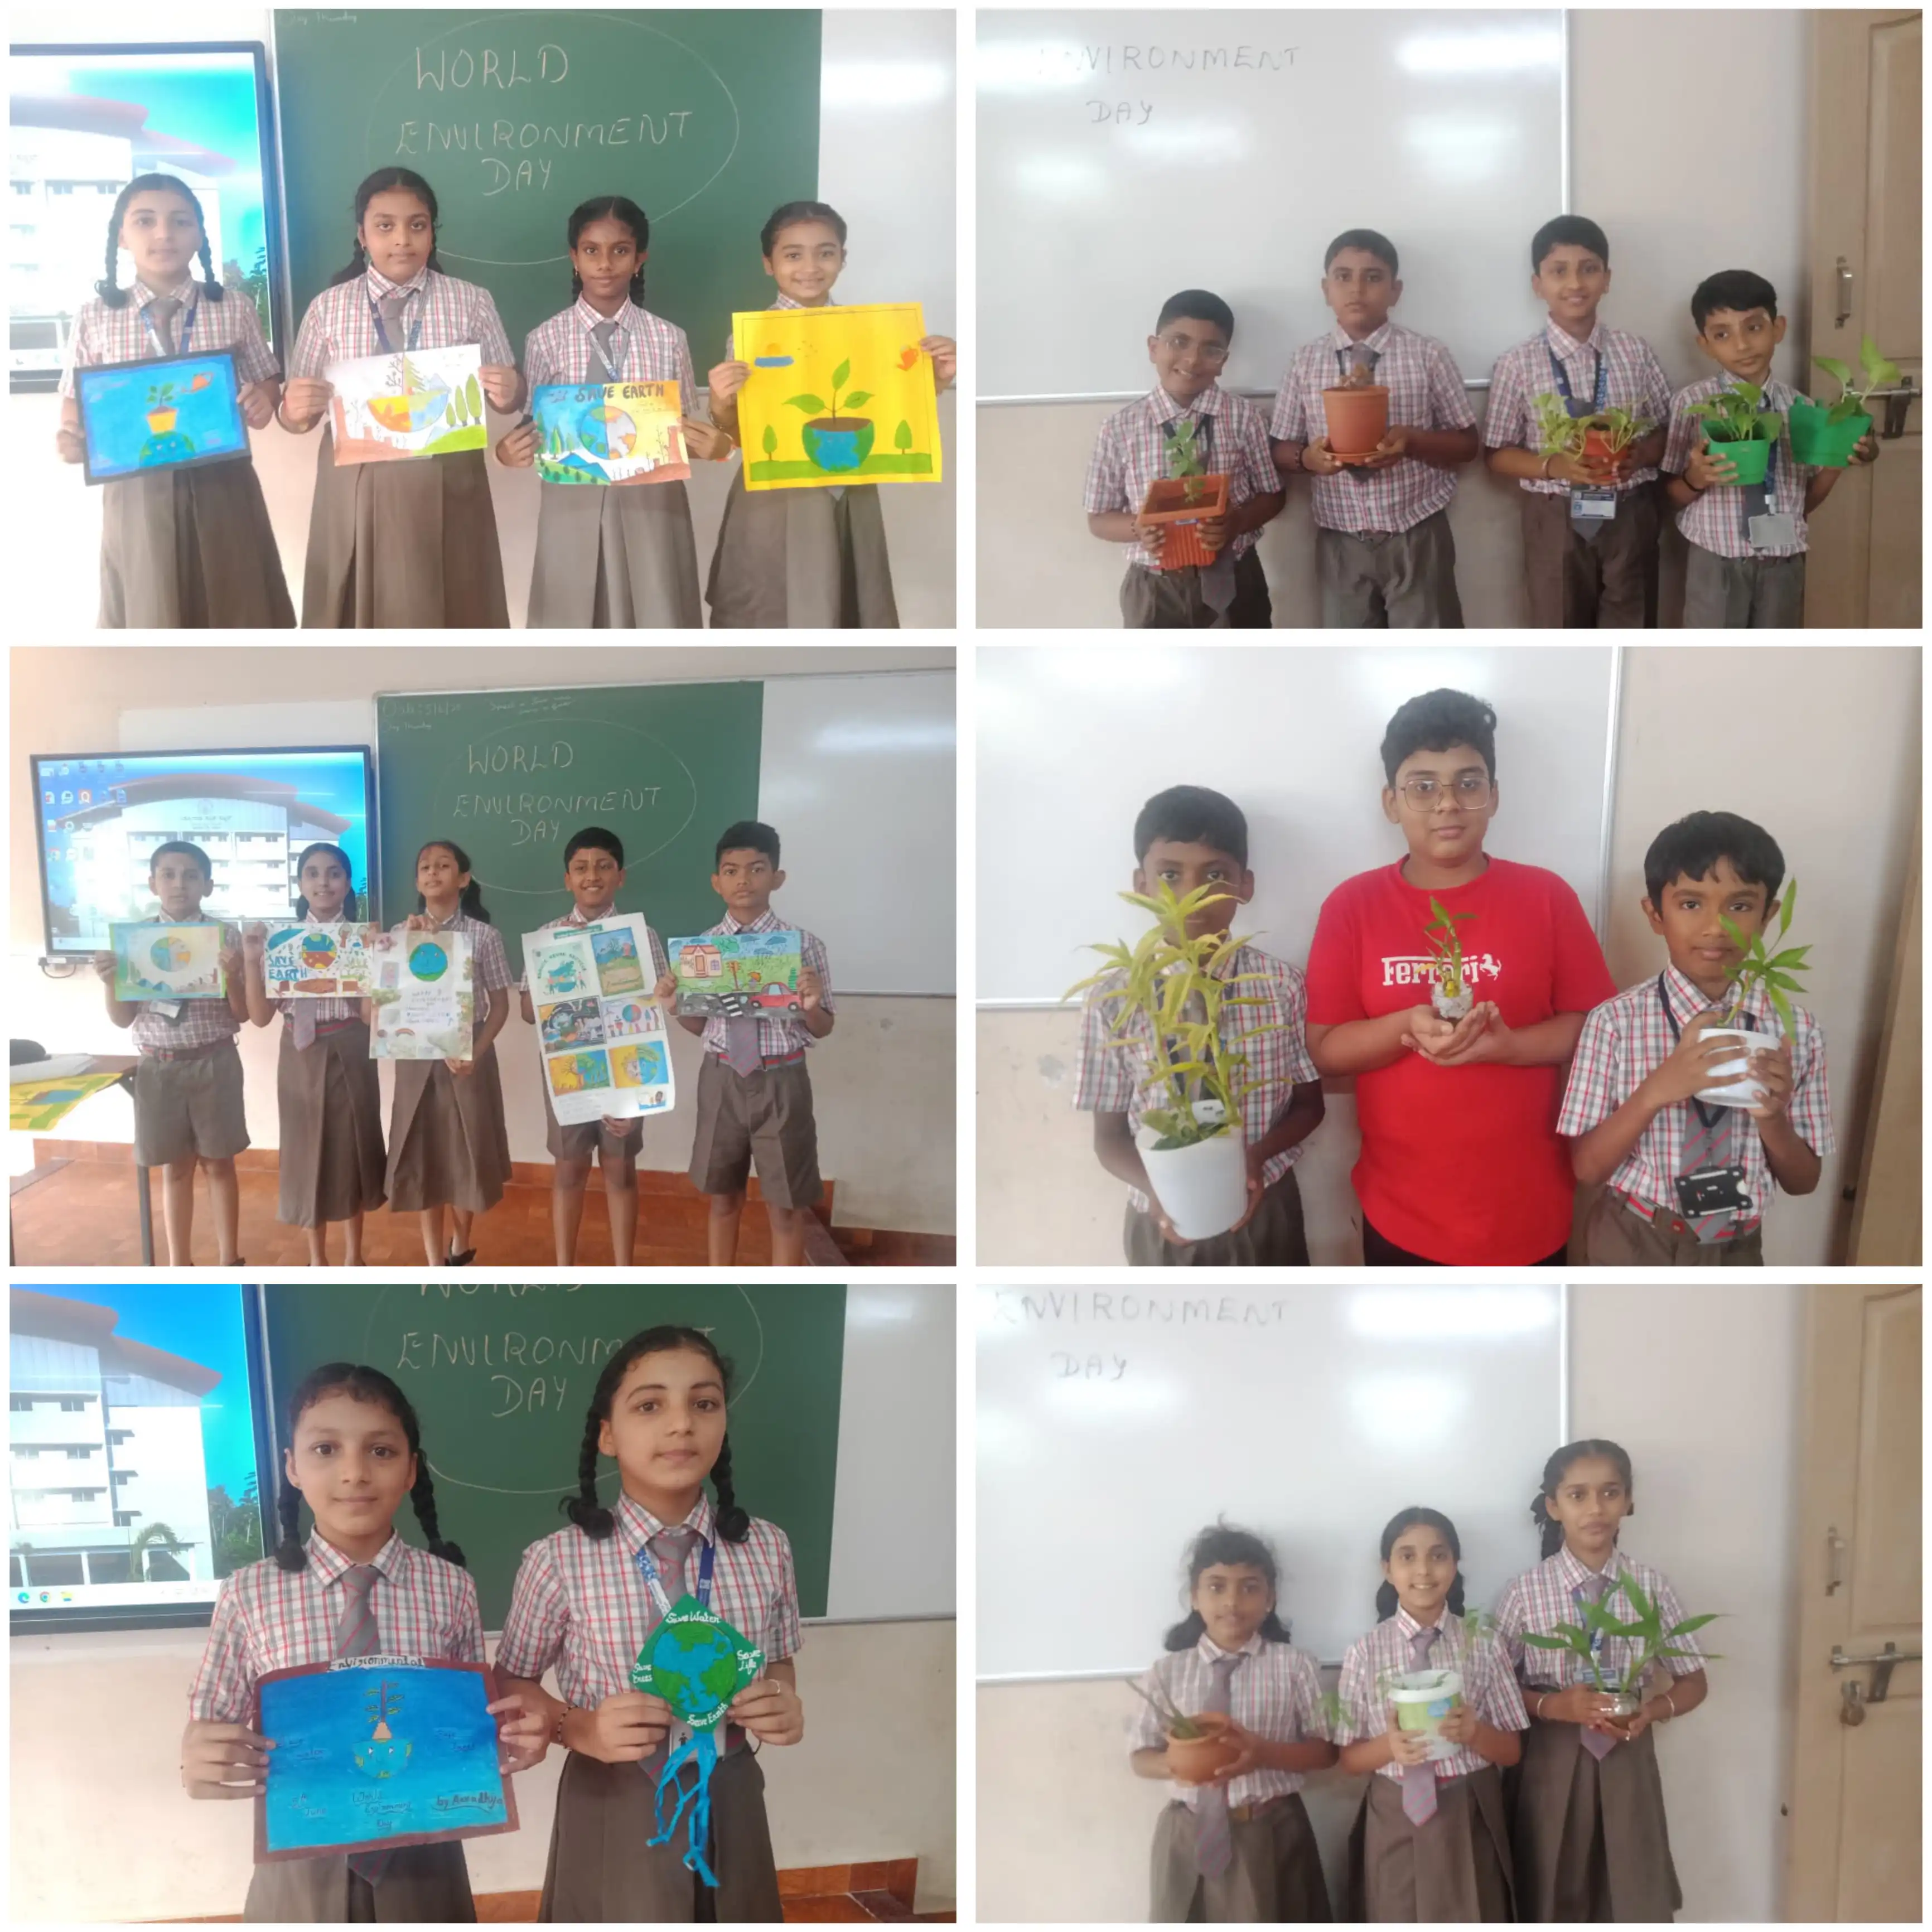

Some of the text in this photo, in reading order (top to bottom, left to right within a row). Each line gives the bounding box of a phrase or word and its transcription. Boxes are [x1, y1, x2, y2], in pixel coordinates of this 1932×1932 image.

[415, 44, 569, 91] WORLD
[1085, 100, 1154, 125] DAY
[395, 111, 693, 154] ENVIRONMENT
[481, 158, 553, 196] DAY
[575, 383, 664, 403] SAVE EARTH
[468, 741, 574, 775] WORLD
[453, 786, 662, 817] ENVIRONMENT
[510, 819, 560, 846] DAY
[268, 967, 307, 982] EARTH
[1050, 1352, 1127, 1382] DAY
[491, 1375, 567, 1417] DAY
[689, 1610, 721, 1624] Water
[737, 1649, 761, 1660] Save
